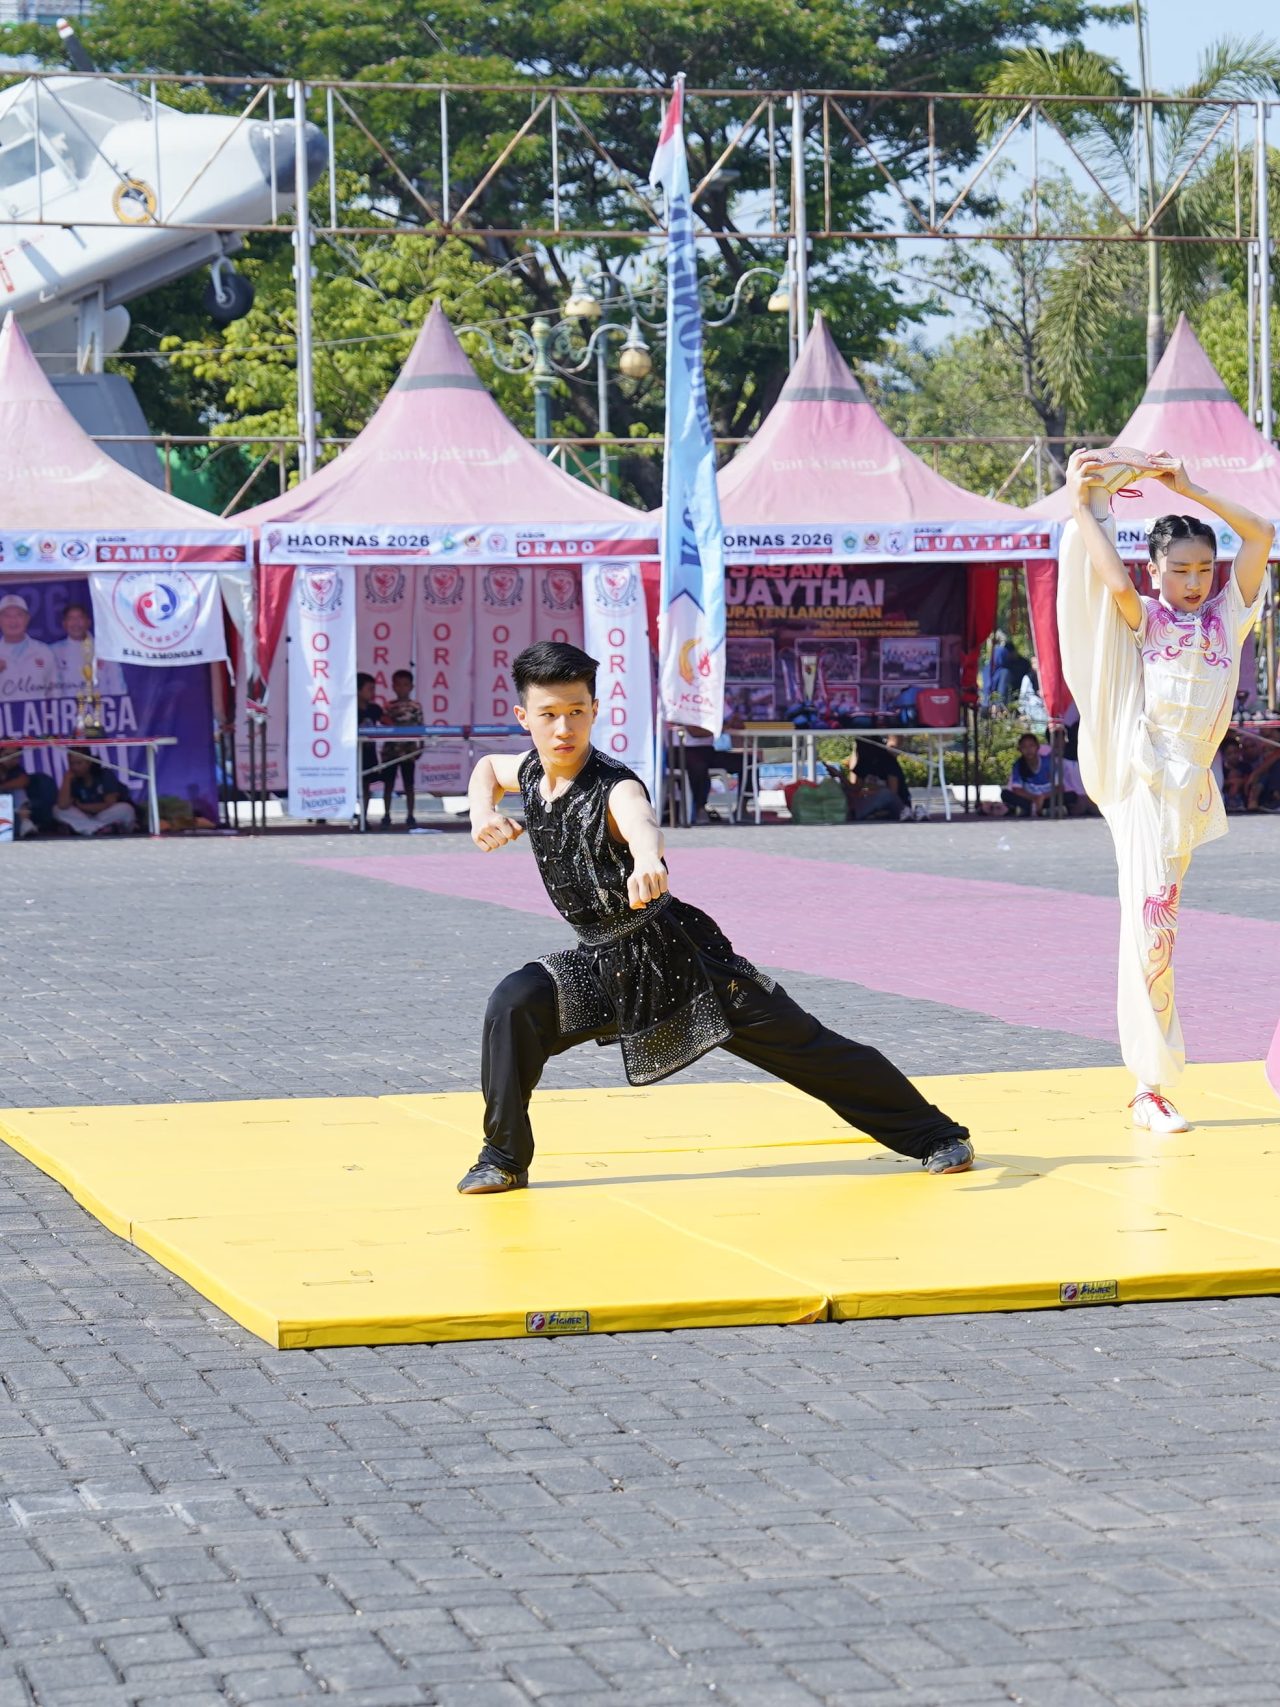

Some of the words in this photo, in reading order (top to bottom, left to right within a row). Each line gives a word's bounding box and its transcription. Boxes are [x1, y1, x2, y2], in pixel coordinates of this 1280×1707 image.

[287, 535, 379, 547] HAORNAS
[387, 535, 430, 547] 2026
[723, 535, 785, 547] ORNAS
[791, 533, 833, 546] 2026
[916, 535, 1042, 549] MUAYTHAI
[99, 546, 177, 561] SAMBO
[517, 541, 595, 555] ORADO
[729, 564, 845, 578] SASANA
[726, 579, 885, 606] UAYTHAI
[727, 606, 786, 619] UPATEN
[789, 606, 883, 619] LAMONGAN
[432, 623, 452, 726] ORAD
[492, 625, 510, 720] ORAD
[312, 632, 331, 758] ORADO
[607, 628, 629, 753] ORADO
[0, 695, 139, 740] LAHRGA
